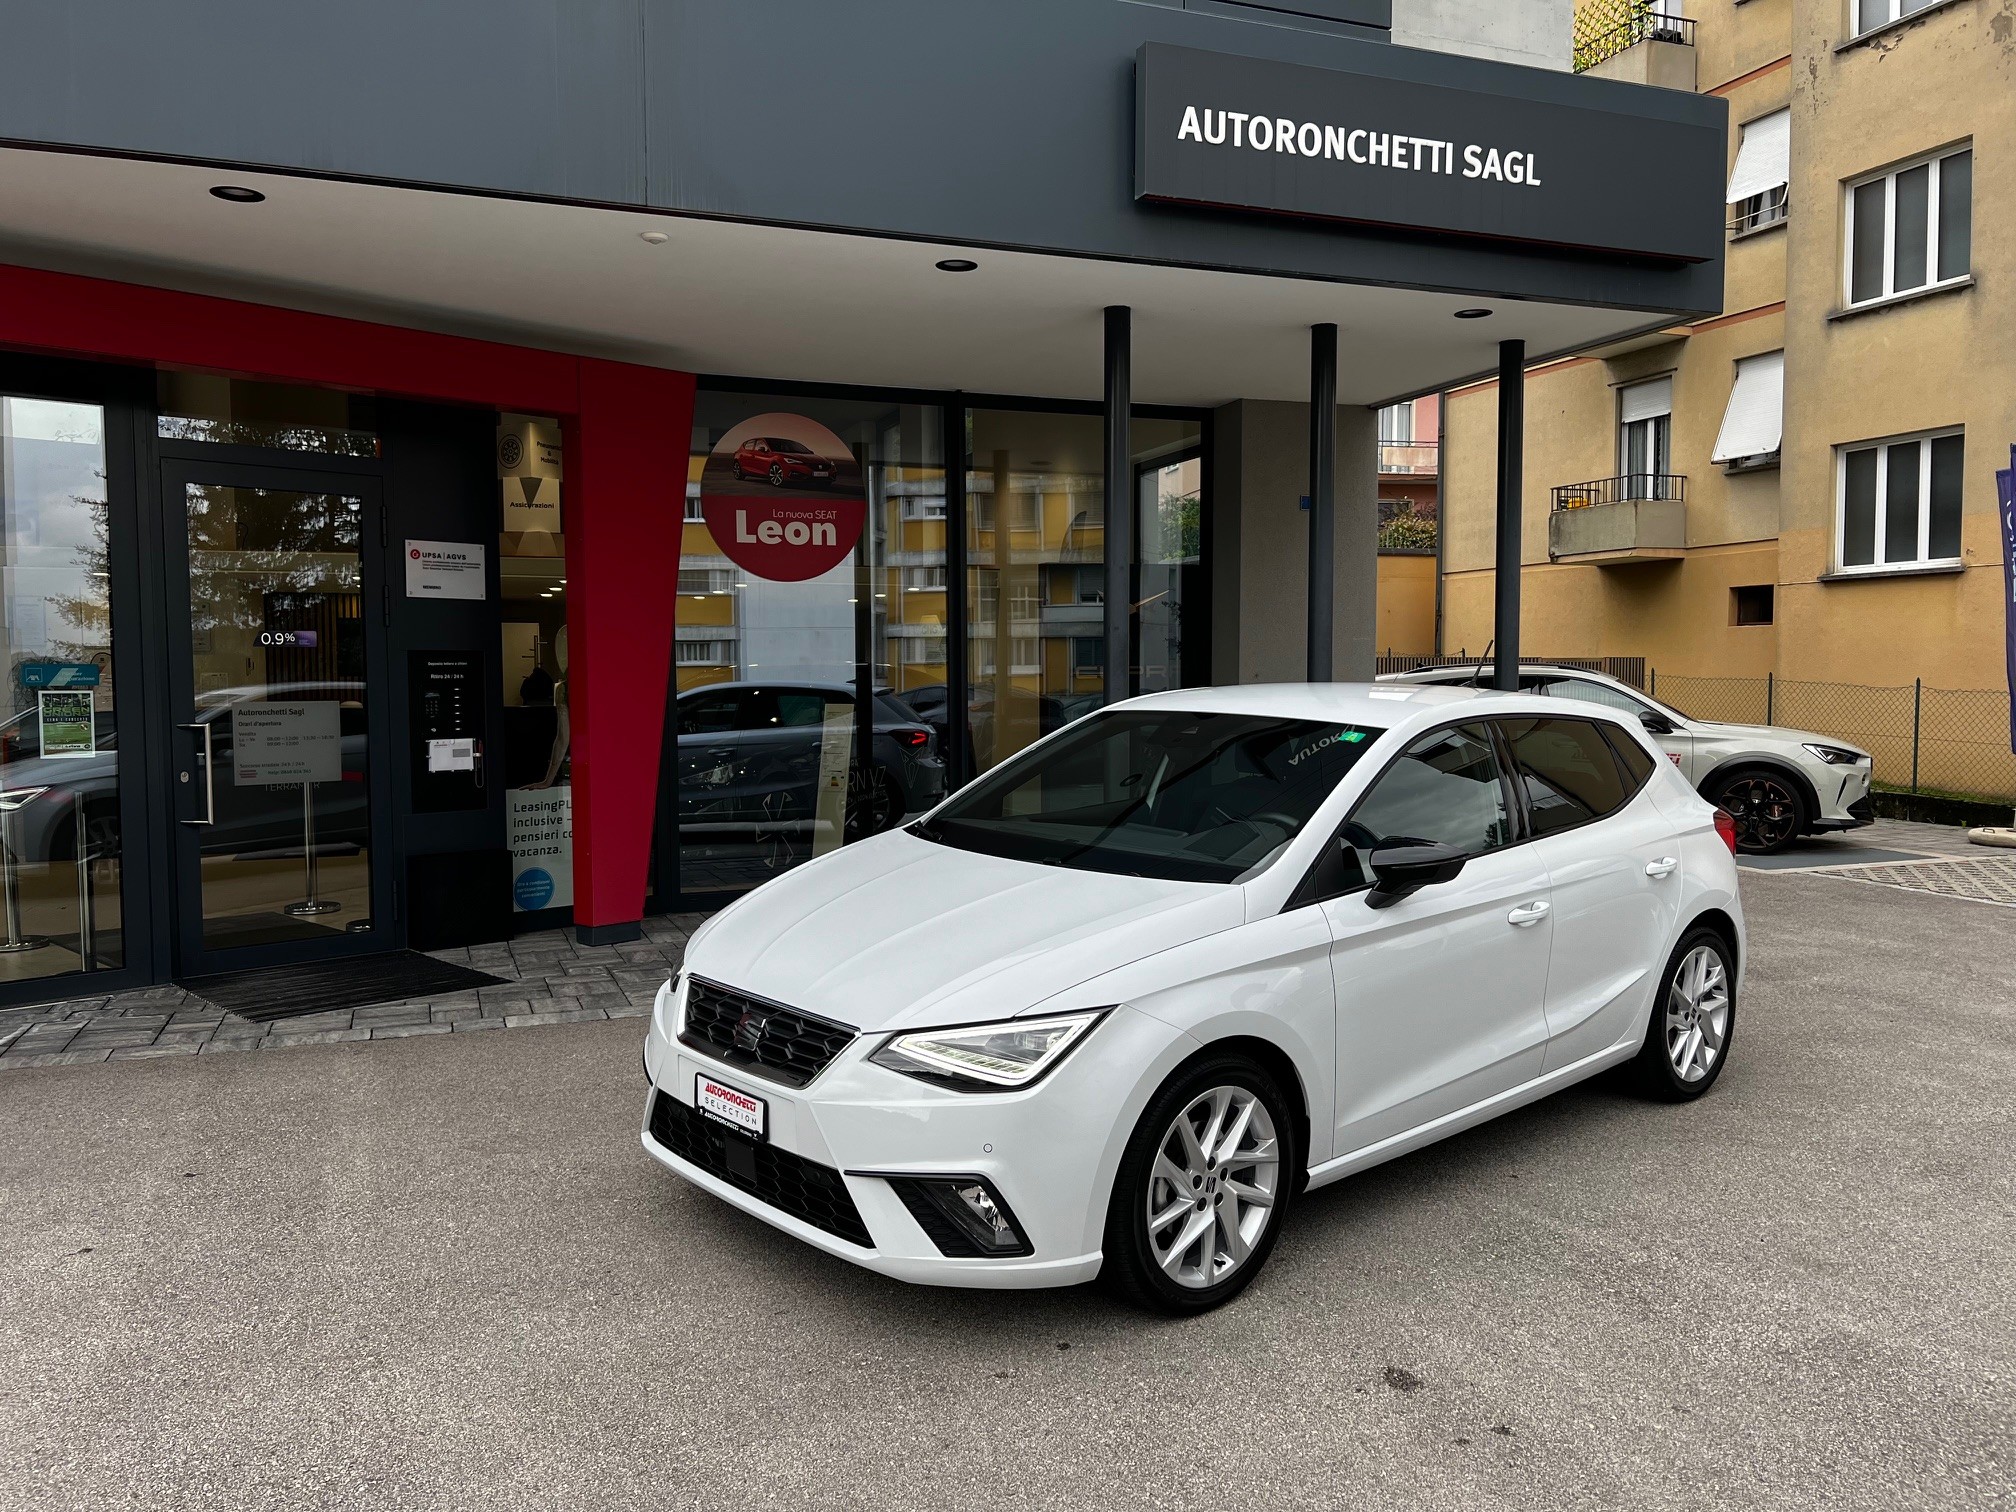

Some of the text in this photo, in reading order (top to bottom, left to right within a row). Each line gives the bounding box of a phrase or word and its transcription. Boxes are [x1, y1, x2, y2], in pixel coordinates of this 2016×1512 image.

[1177, 105, 1542, 187] AUTORONCHETTI SAGL
[509, 501, 555, 509] Assicurazioni
[772, 508, 837, 520] La nuova SEAT
[735, 509, 837, 546] Leon
[260, 632, 296, 645] 0.9%
[238, 708, 305, 716] Autoronchetti Sagl
[265, 782, 320, 792] TERRAMR
[513, 800, 572, 813] LeasingPL
[513, 816, 563, 828] inclusive
[513, 829, 559, 845] pensieri
[513, 846, 562, 858] vacanza.
[704, 1096, 757, 1125] SELECTION
